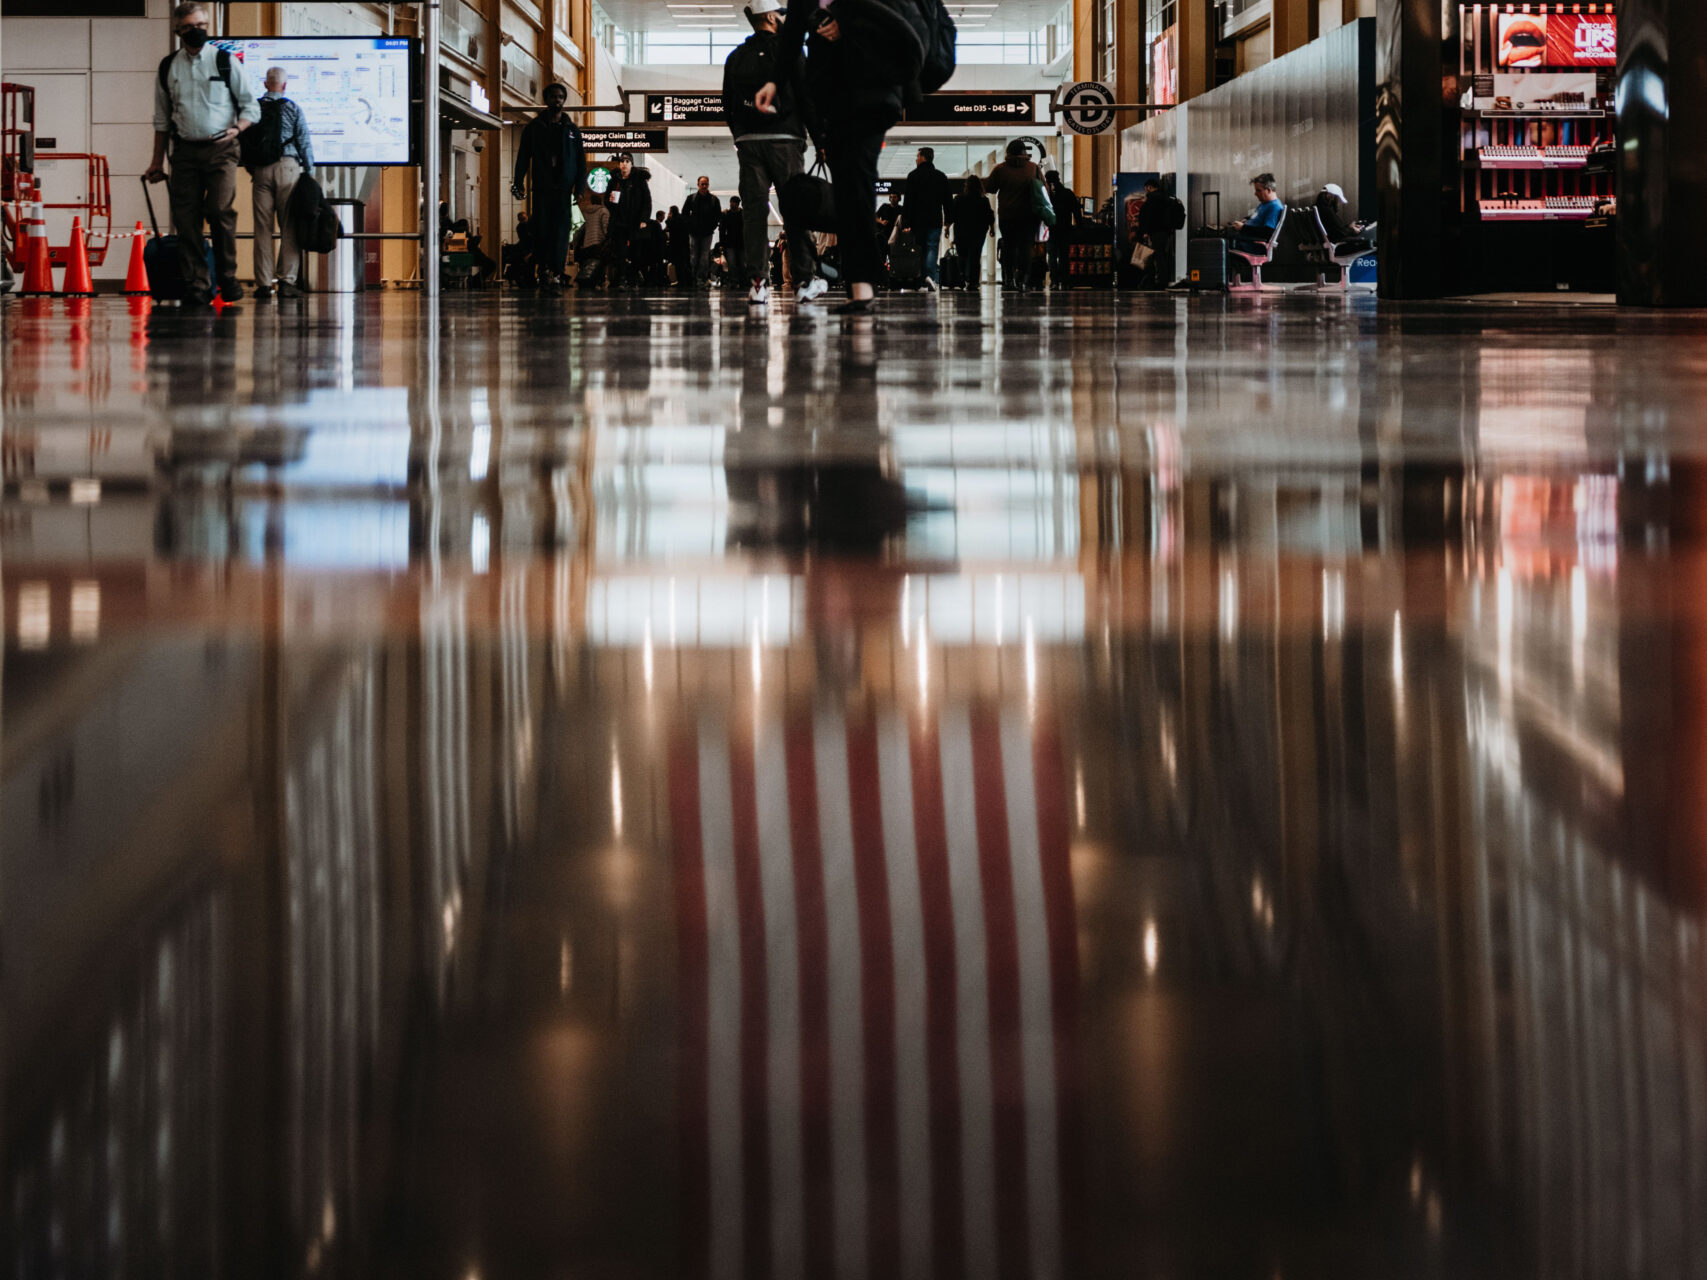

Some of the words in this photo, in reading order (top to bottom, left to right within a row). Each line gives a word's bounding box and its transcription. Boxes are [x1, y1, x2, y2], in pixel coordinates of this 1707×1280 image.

[1574, 28, 1615, 48] LIPS
[1070, 83, 1103, 95] TERMINAL
[673, 97, 702, 105] Baggage
[954, 104, 973, 112] Gates
[973, 104, 987, 112] D35
[992, 104, 1006, 112] D45
[1080, 95, 1103, 122] D
